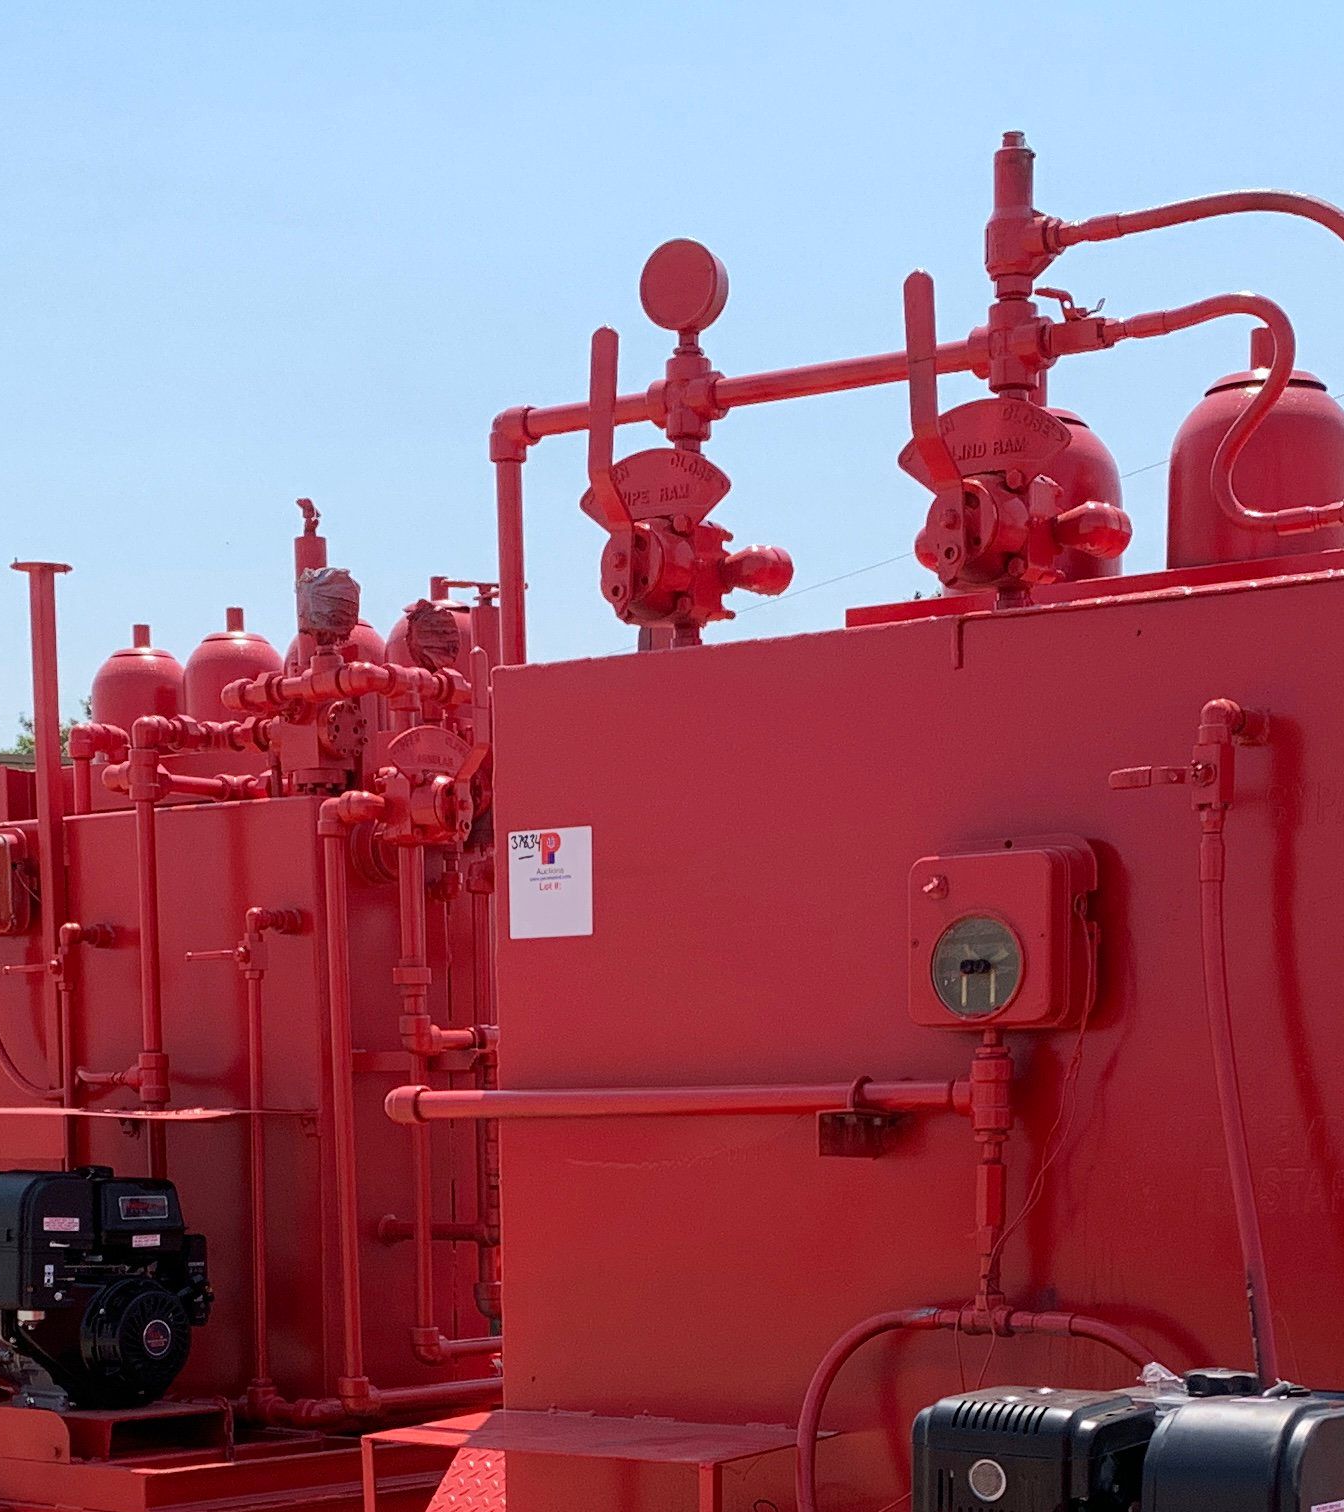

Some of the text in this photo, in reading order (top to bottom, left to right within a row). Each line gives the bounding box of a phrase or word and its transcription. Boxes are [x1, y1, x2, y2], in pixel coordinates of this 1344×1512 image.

[1001, 404, 1055, 440] CLOSE
[952, 437, 1027, 461] LIND RAM
[670, 452, 716, 482] CLOSE
[622, 483, 690, 507] IPE RAM
[539, 882, 553, 891] Lot
